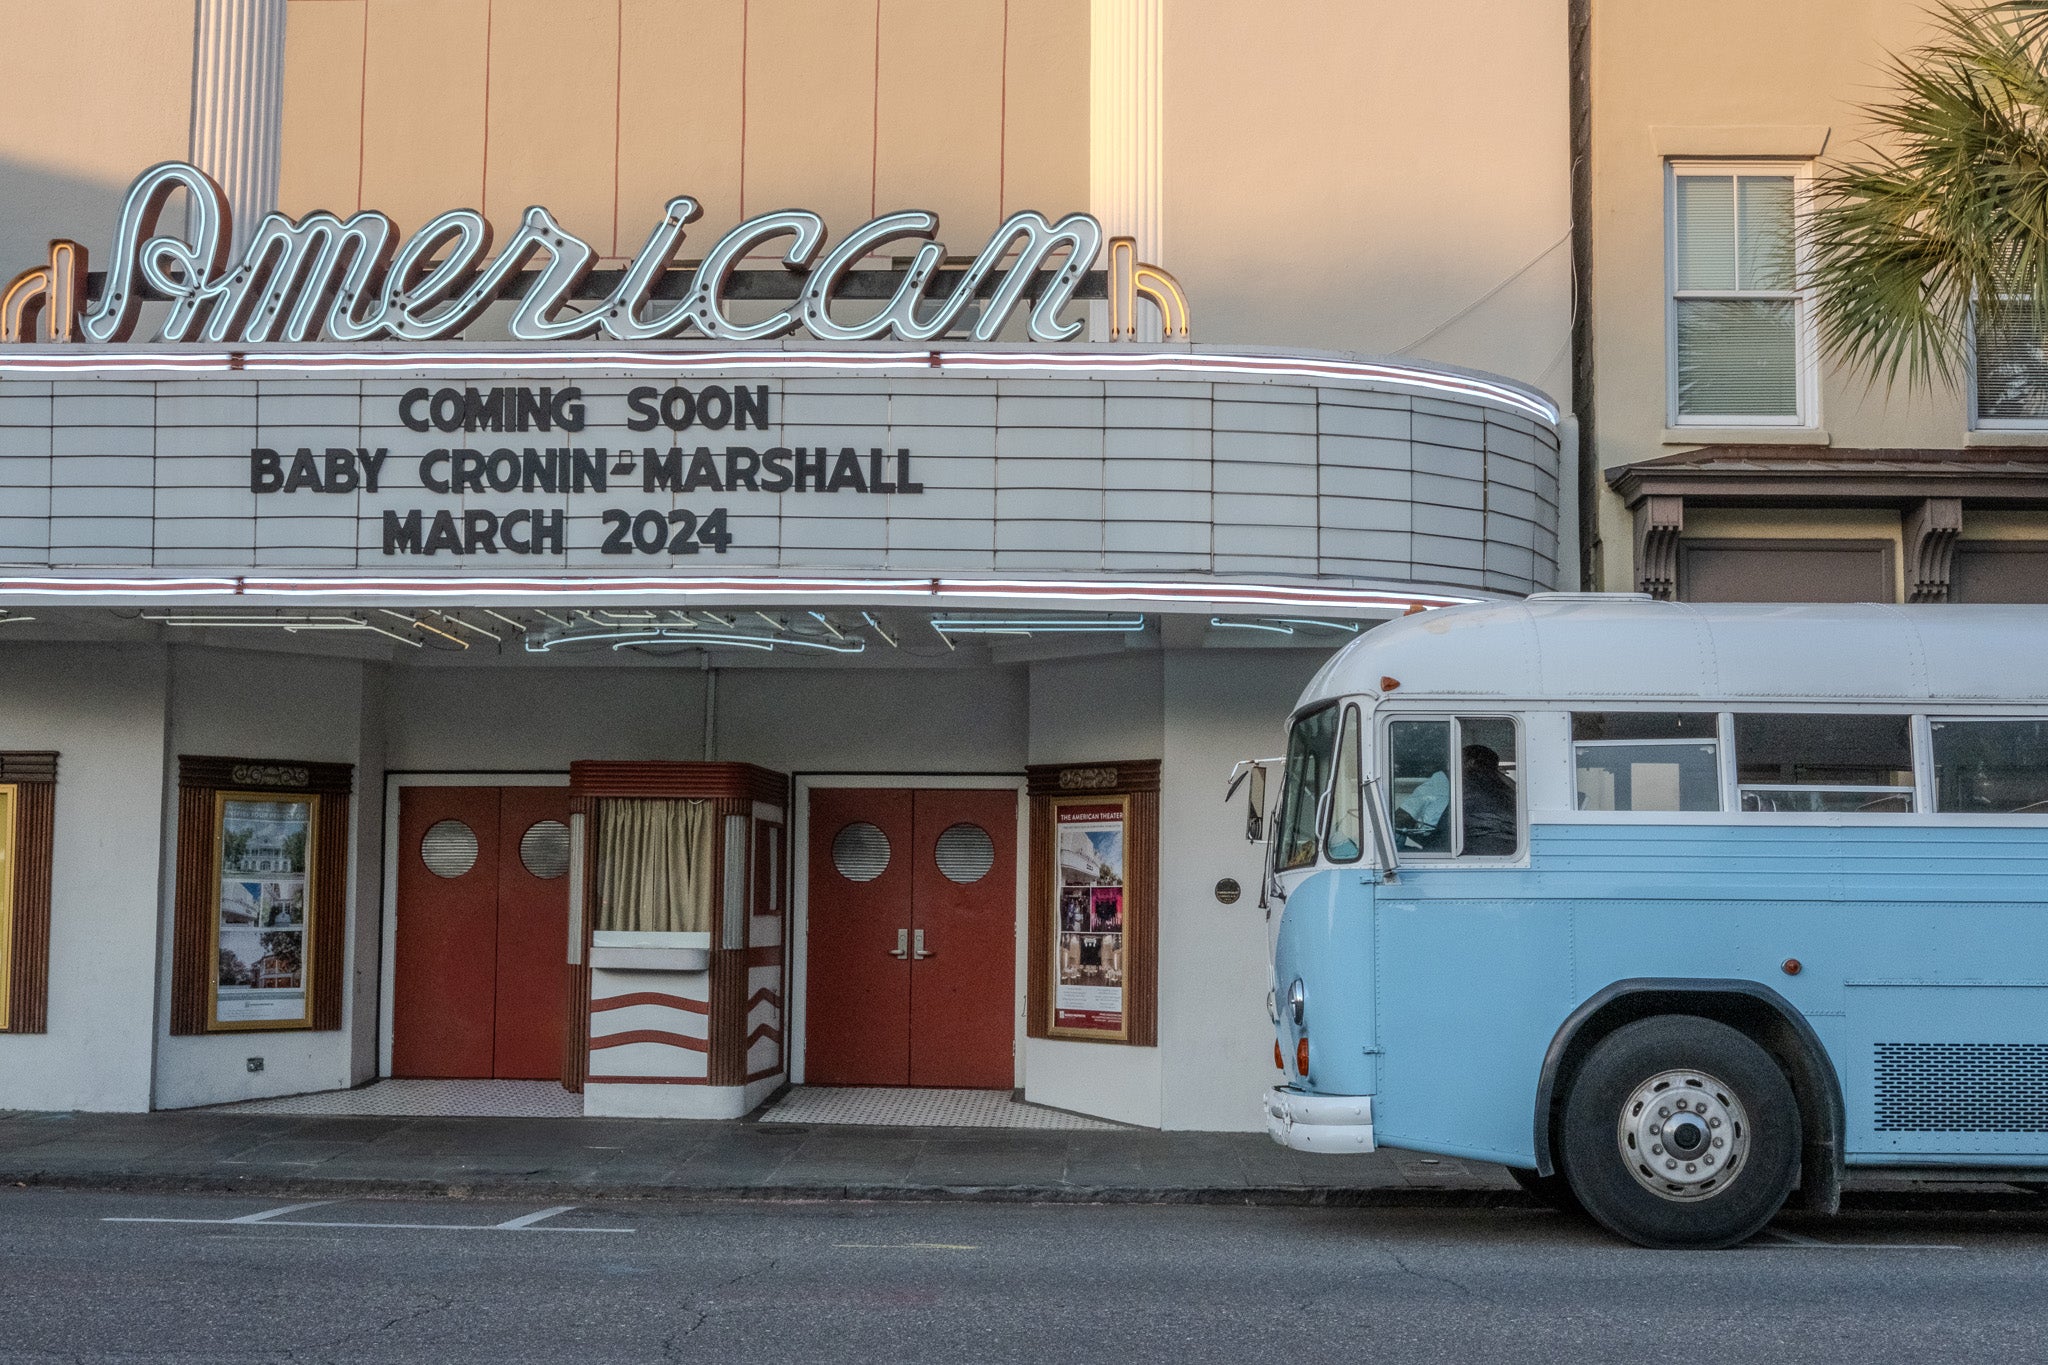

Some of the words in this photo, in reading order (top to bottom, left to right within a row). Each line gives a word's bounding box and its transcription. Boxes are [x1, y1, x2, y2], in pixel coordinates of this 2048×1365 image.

[80, 160, 1102, 343] American
[399, 387, 586, 433] COMING
[628, 386, 769, 432] SOON
[251, 448, 388, 494] BABY
[420, 447, 924, 495] CRONIN-MARSHALL
[383, 510, 564, 556] MARCH
[601, 509, 733, 555] 2024
[1101, 812, 1123, 820] THEATER
